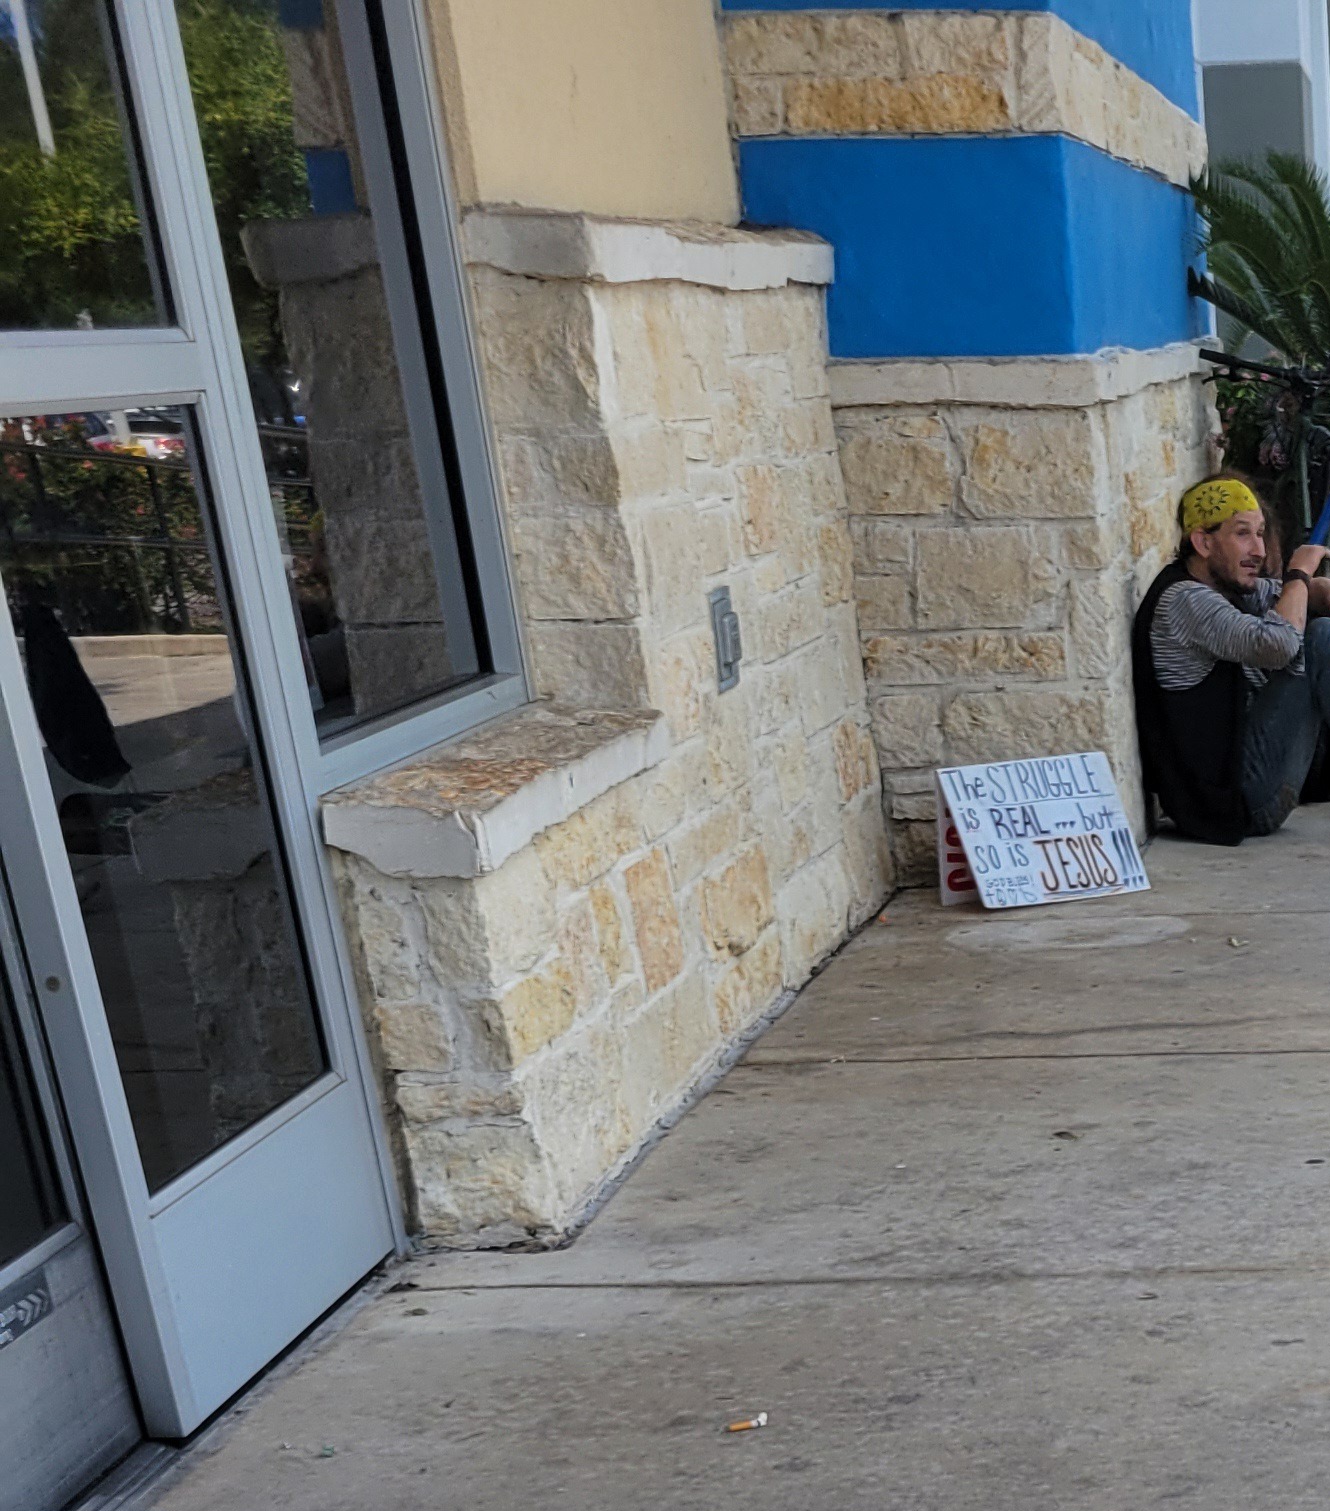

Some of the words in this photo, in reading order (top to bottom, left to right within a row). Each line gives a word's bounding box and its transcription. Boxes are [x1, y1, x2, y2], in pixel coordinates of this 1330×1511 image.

[940, 769, 987, 802] The
[986, 754, 1100, 804] STRUGGLE
[1076, 802, 1114, 832] but
